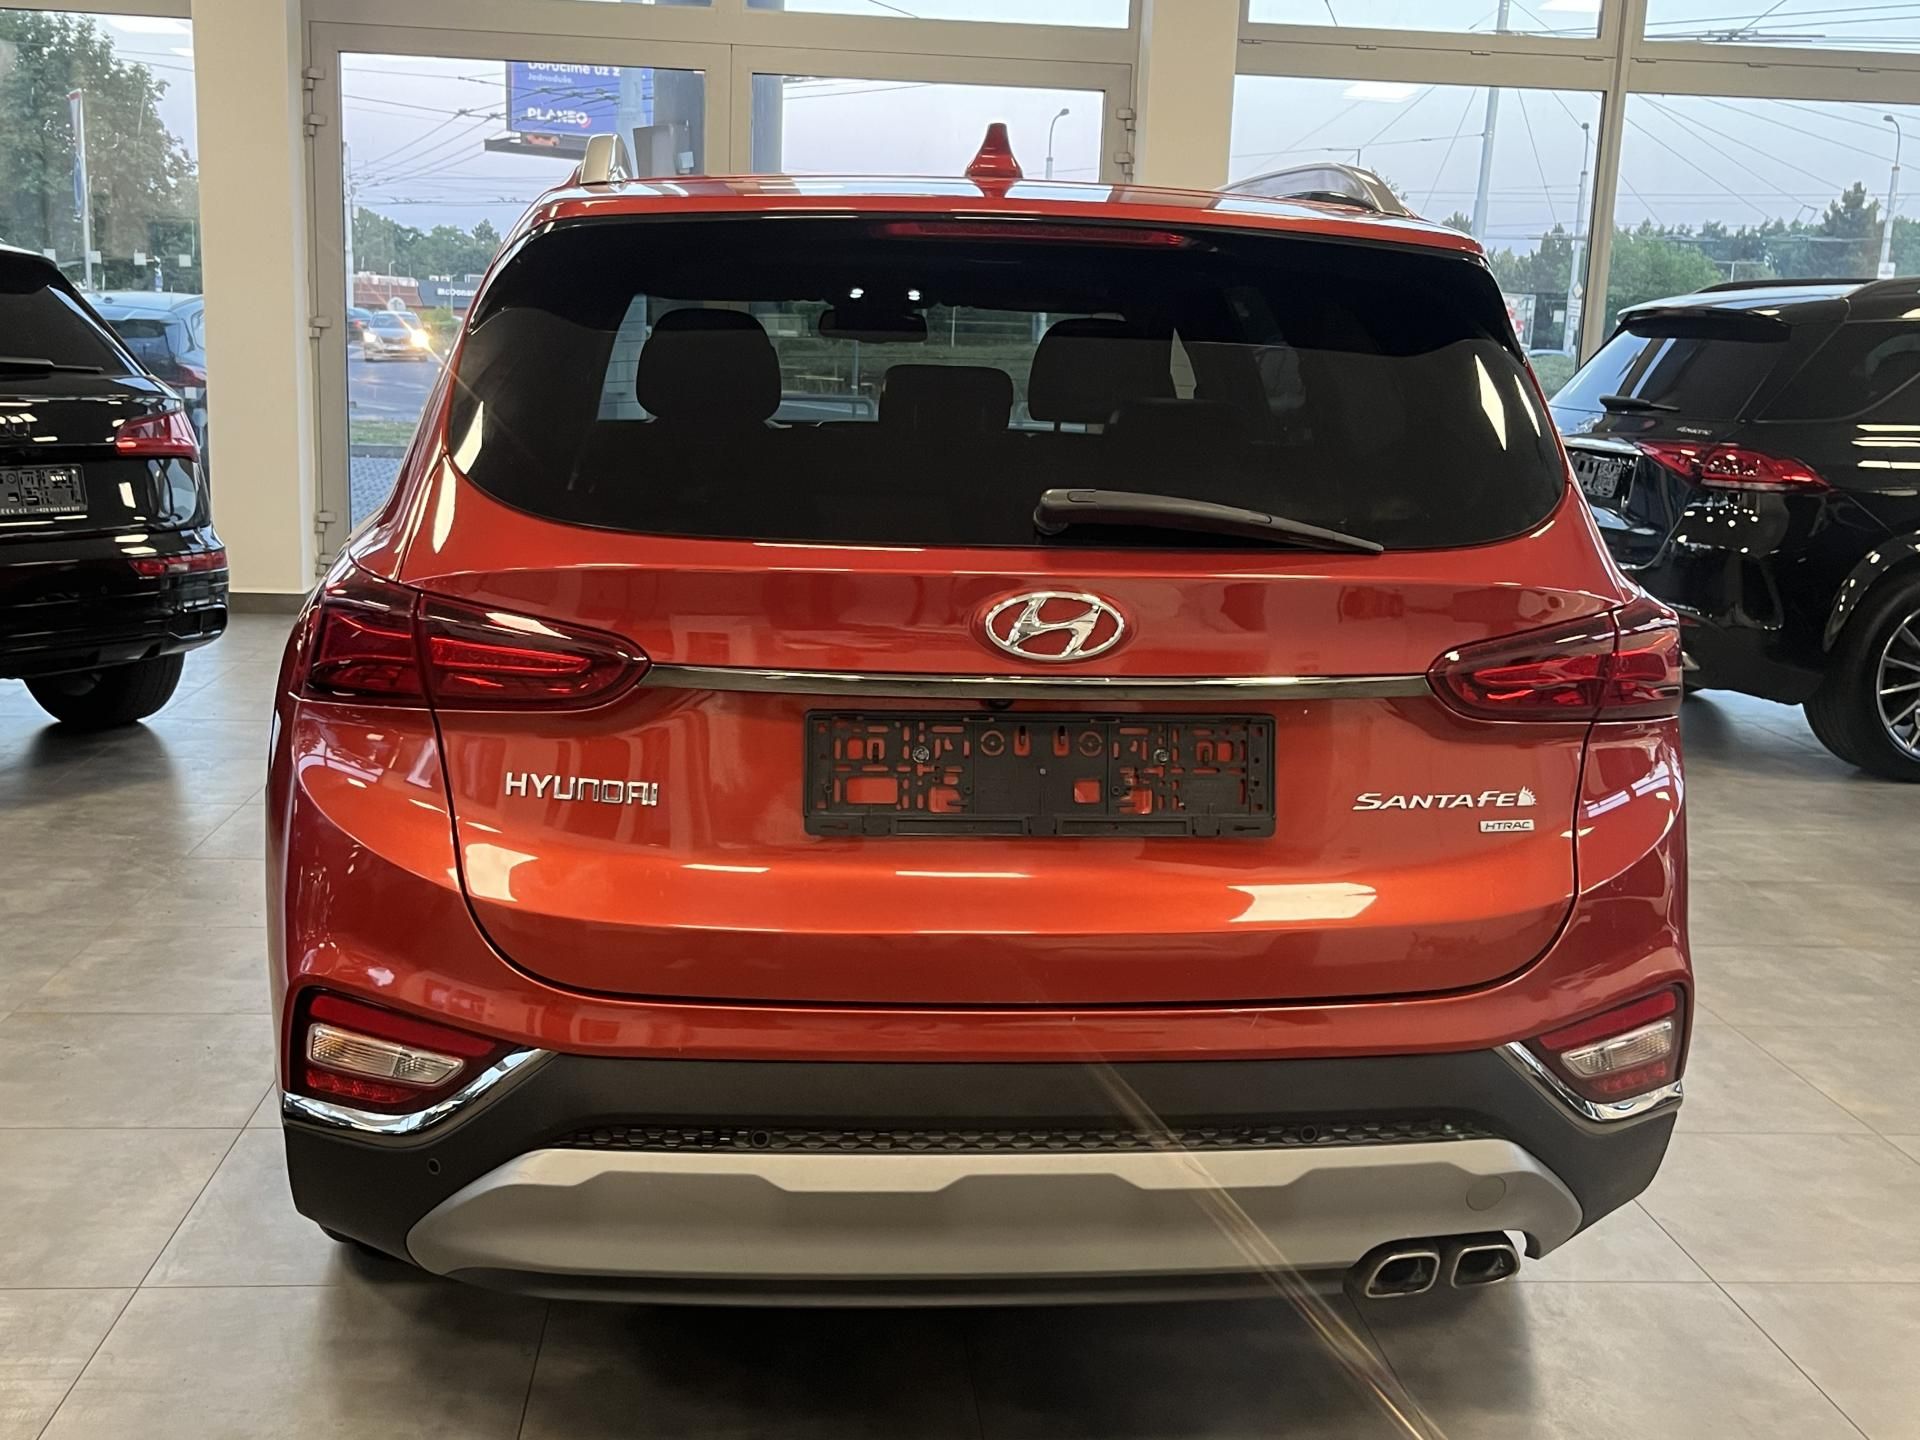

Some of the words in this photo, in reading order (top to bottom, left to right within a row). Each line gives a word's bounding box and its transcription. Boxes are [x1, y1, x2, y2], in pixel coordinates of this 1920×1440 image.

[527, 107, 588, 125] PLANEO
[505, 772, 659, 806] HYUNDAI
[1484, 820, 1532, 832] HTRAC
